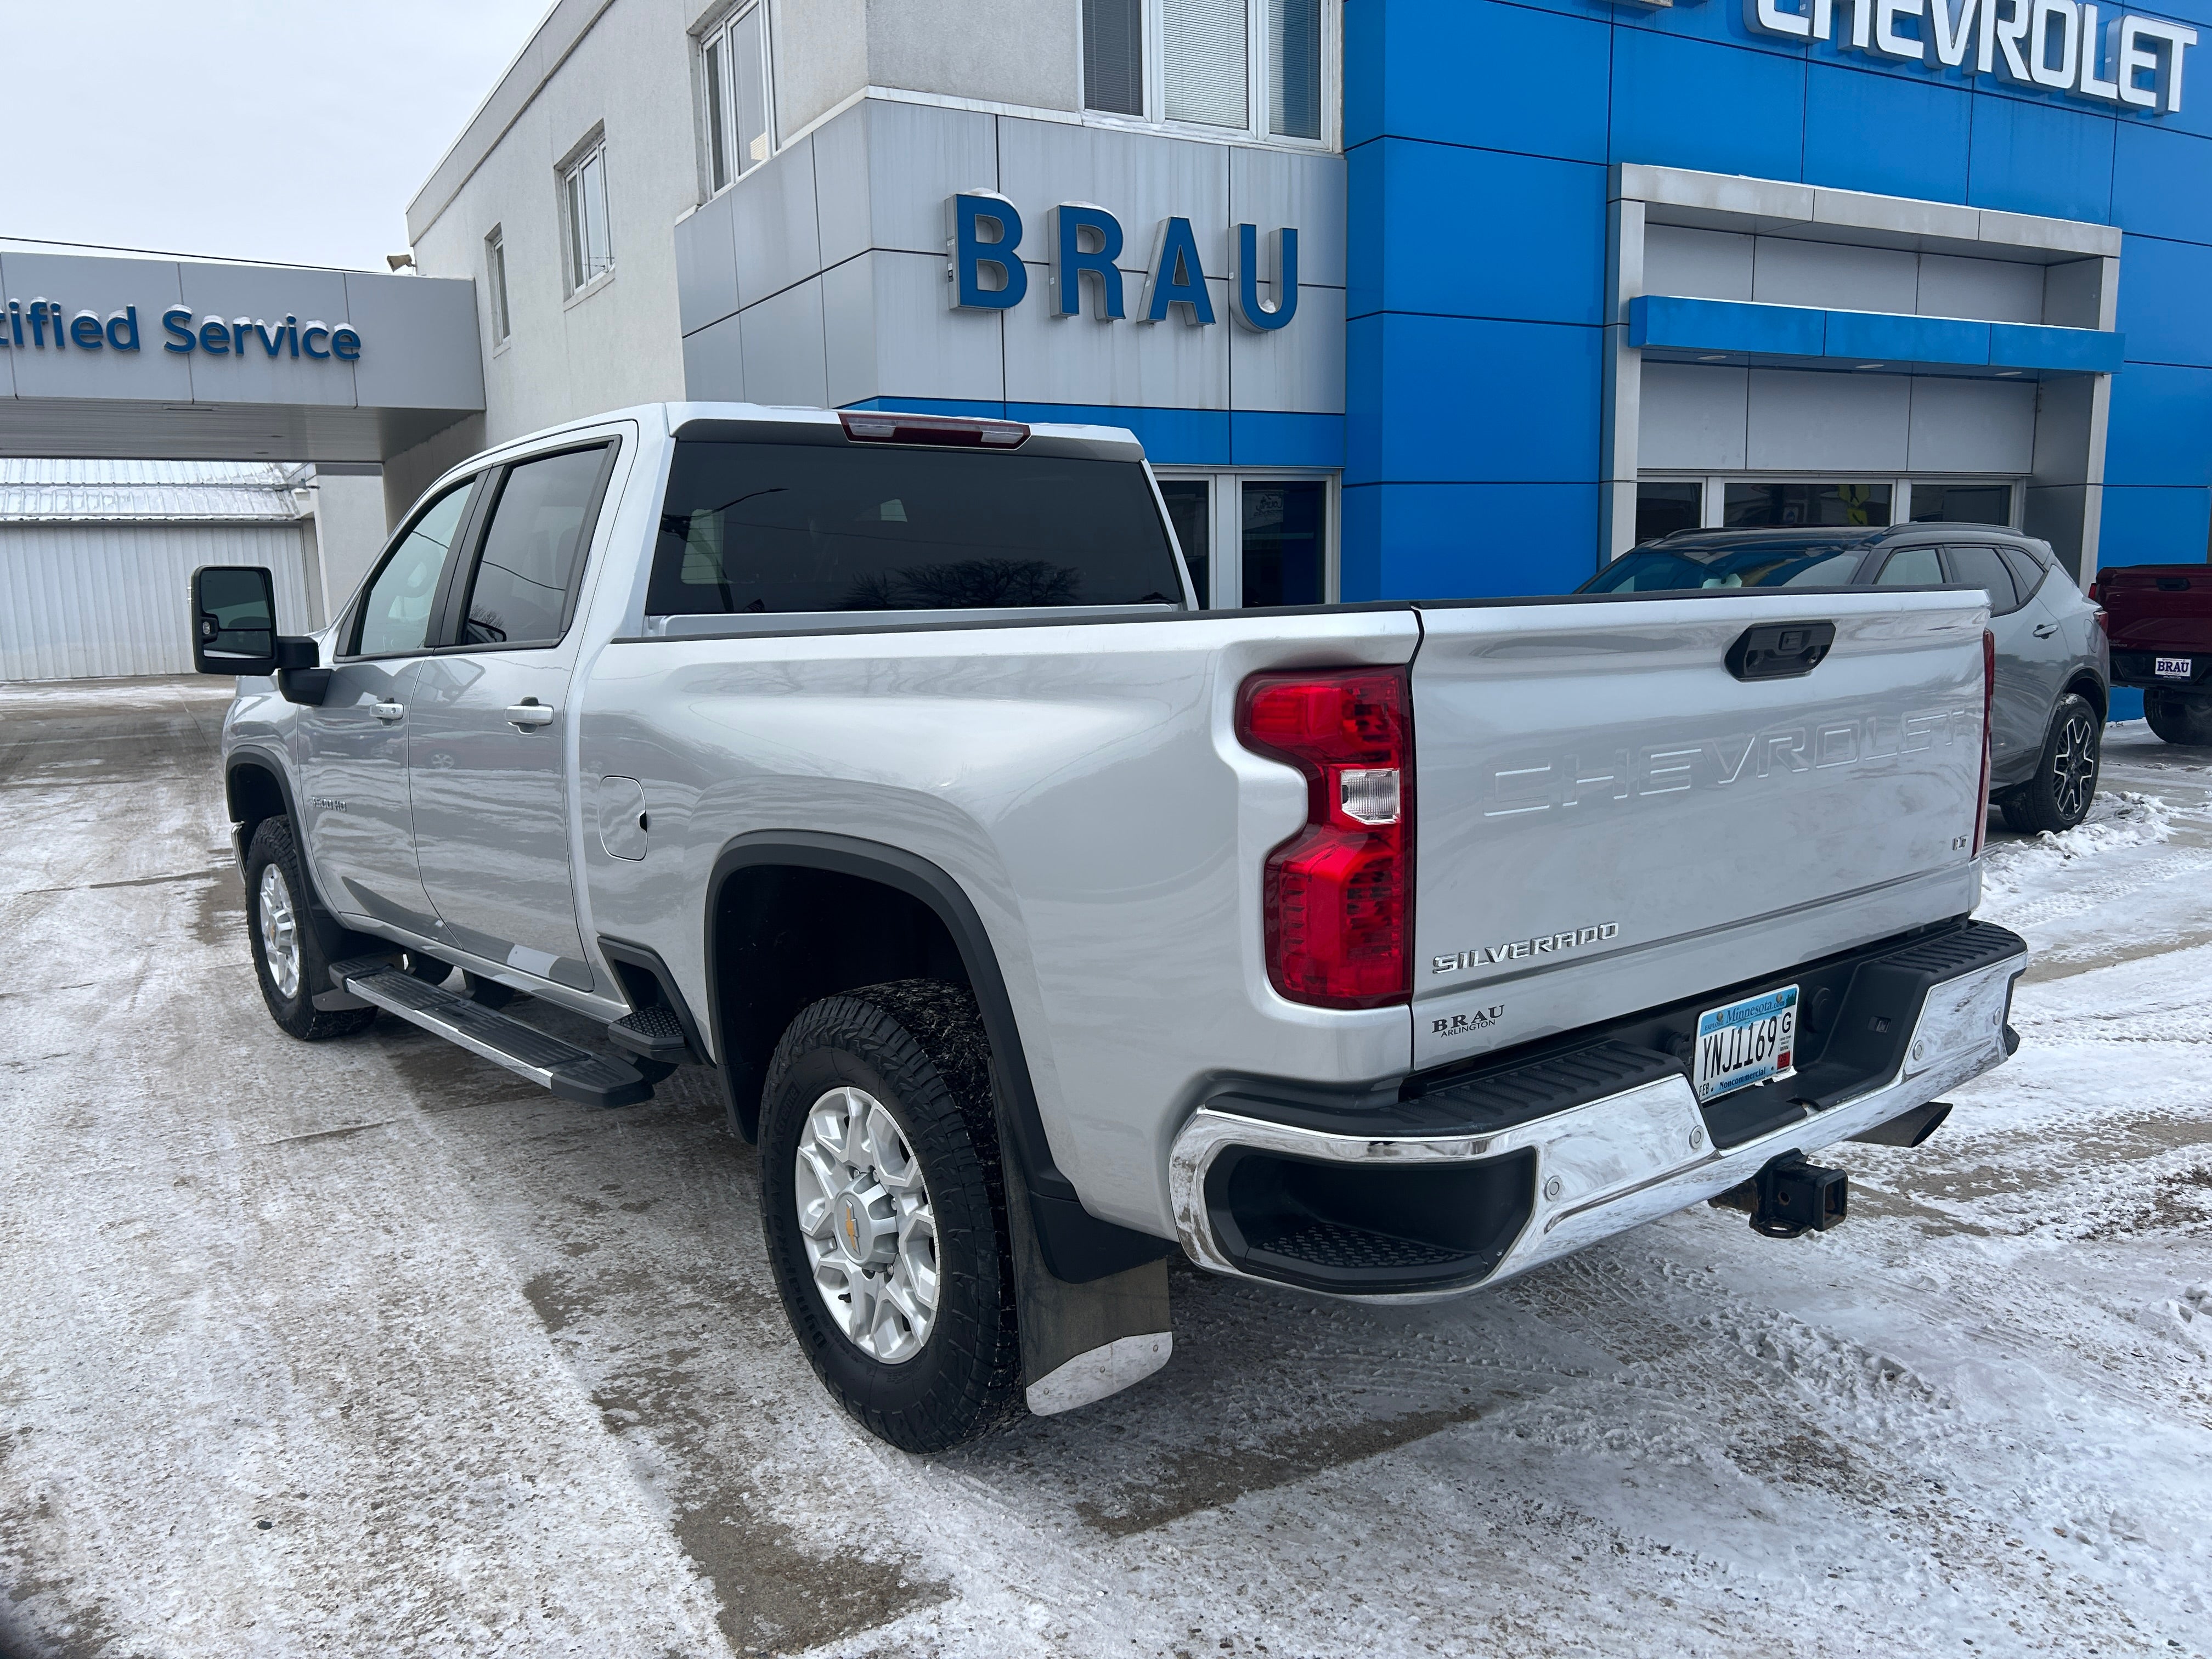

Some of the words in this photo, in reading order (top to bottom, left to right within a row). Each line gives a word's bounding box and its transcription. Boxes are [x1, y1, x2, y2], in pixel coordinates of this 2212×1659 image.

[946, 193, 1298, 331] BRAU
[163, 308, 361, 362] Service
[2157, 661, 2190, 673] BRAU
[1482, 705, 1965, 817] CHEVROLET
[1432, 921, 1619, 974] SILVERADO
[1432, 1005, 1505, 1033] BRAU
[1441, 1019, 1495, 1038] ARLINGTON
[1703, 1015, 1778, 1081] YNJ1169
[1699, 1082, 1709, 1097] FEB
[1719, 1067, 1766, 1090] Noncommercial
